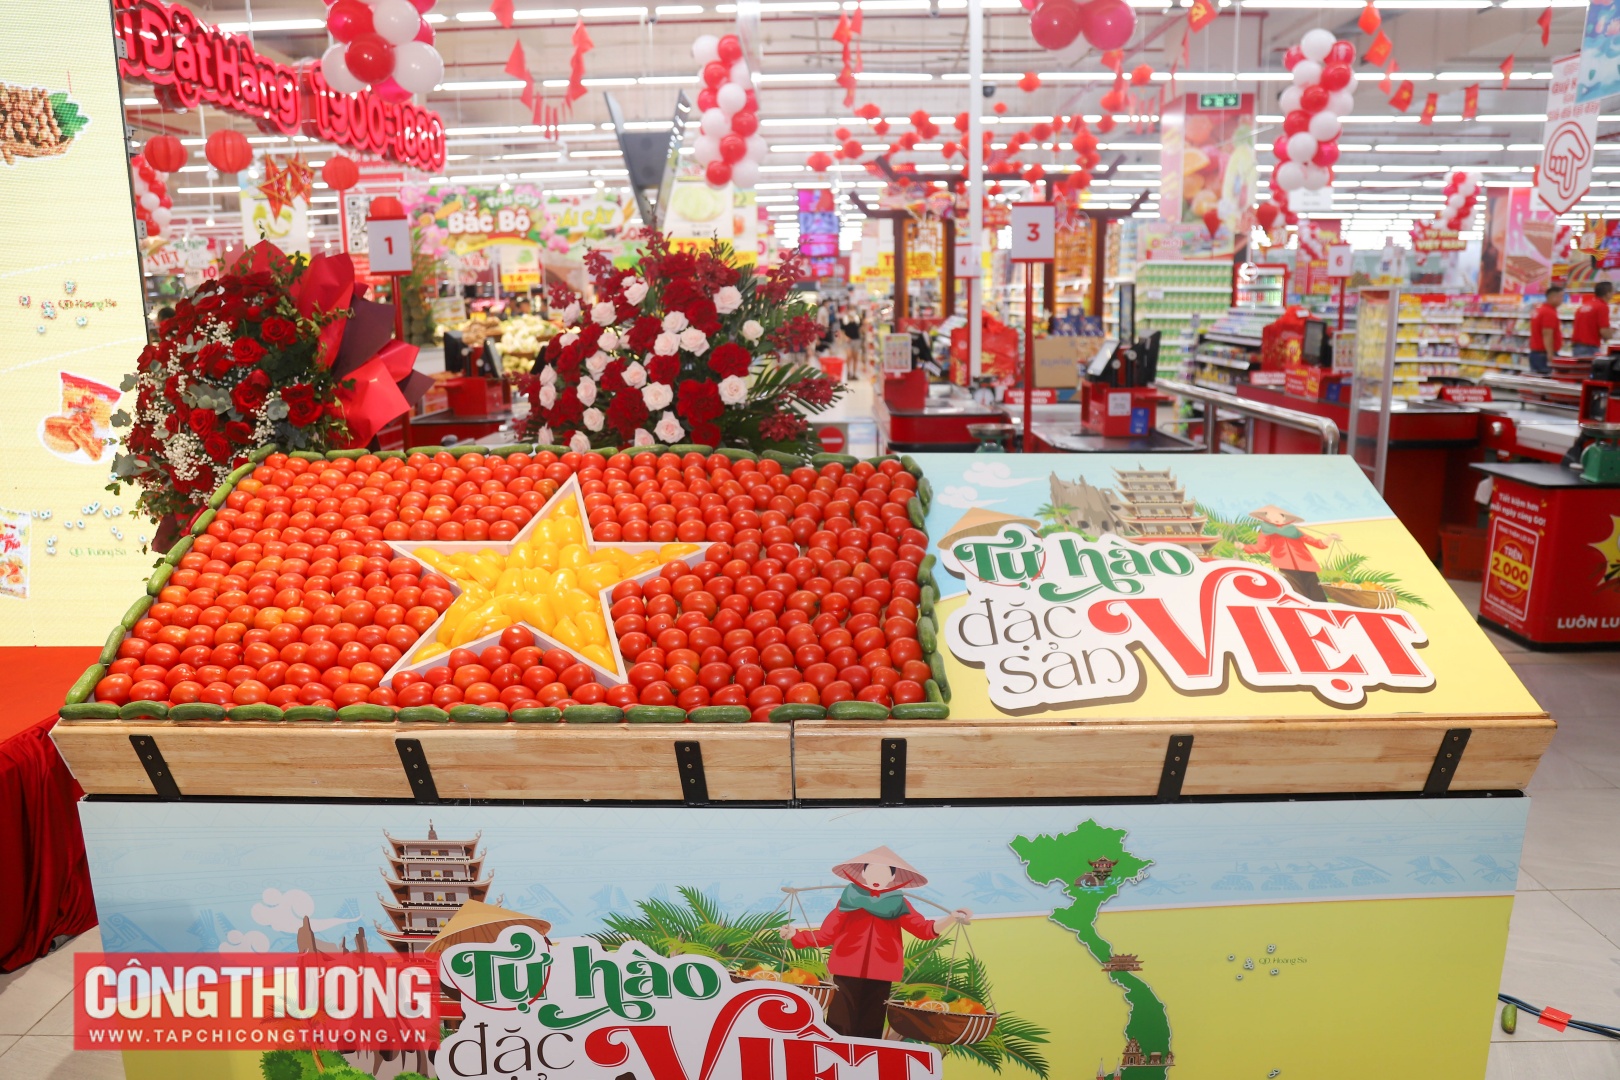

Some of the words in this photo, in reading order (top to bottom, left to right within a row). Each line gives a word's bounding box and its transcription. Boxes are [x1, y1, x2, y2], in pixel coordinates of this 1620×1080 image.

[448, 202, 493, 234] Bắc
[499, 208, 531, 238] Bộ
[1026, 223, 1040, 242] 3
[384, 236, 393, 255] 1
[1335, 255, 1344, 266] 6
[954, 531, 1044, 589] Tự
[1040, 533, 1194, 601] hào
[1504, 545, 1522, 561] TRÊN
[959, 598, 1082, 649] đặc
[1088, 567, 1427, 692] VIỆT
[1557, 615, 1598, 629] LUÔN
[1000, 641, 1126, 695] sản
[452, 933, 553, 1013] Tự
[538, 946, 722, 1028] hào
